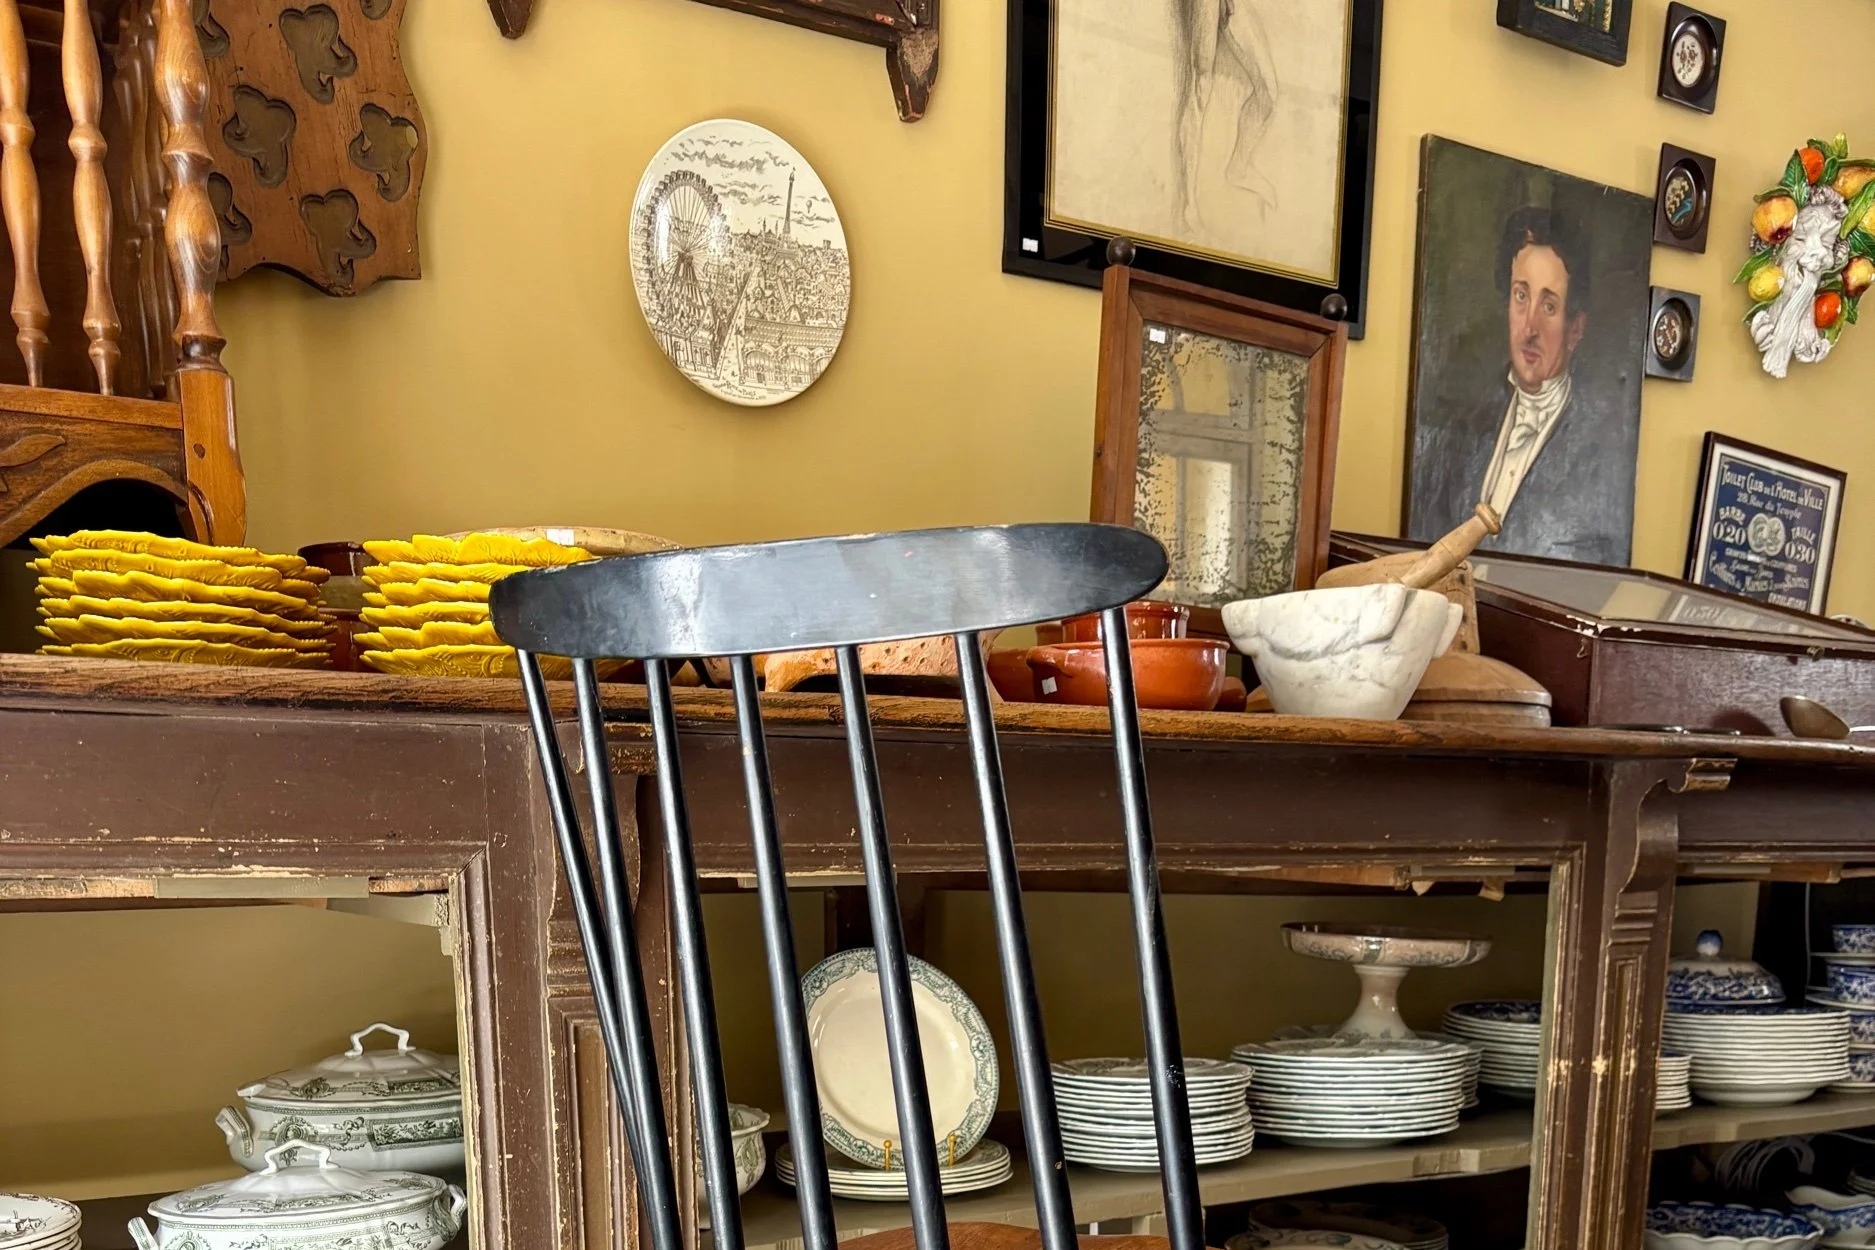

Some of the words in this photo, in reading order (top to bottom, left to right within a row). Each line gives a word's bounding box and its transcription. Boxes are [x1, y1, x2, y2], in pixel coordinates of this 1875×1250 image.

[1721, 464, 1746, 489] TOILET
[1747, 472, 1765, 494] CLUB
[1804, 488, 1824, 511] VILLE
[1719, 506, 1746, 526] BARBE
[1776, 503, 1802, 520] Temple
[1791, 526, 1816, 545] TAILLE
